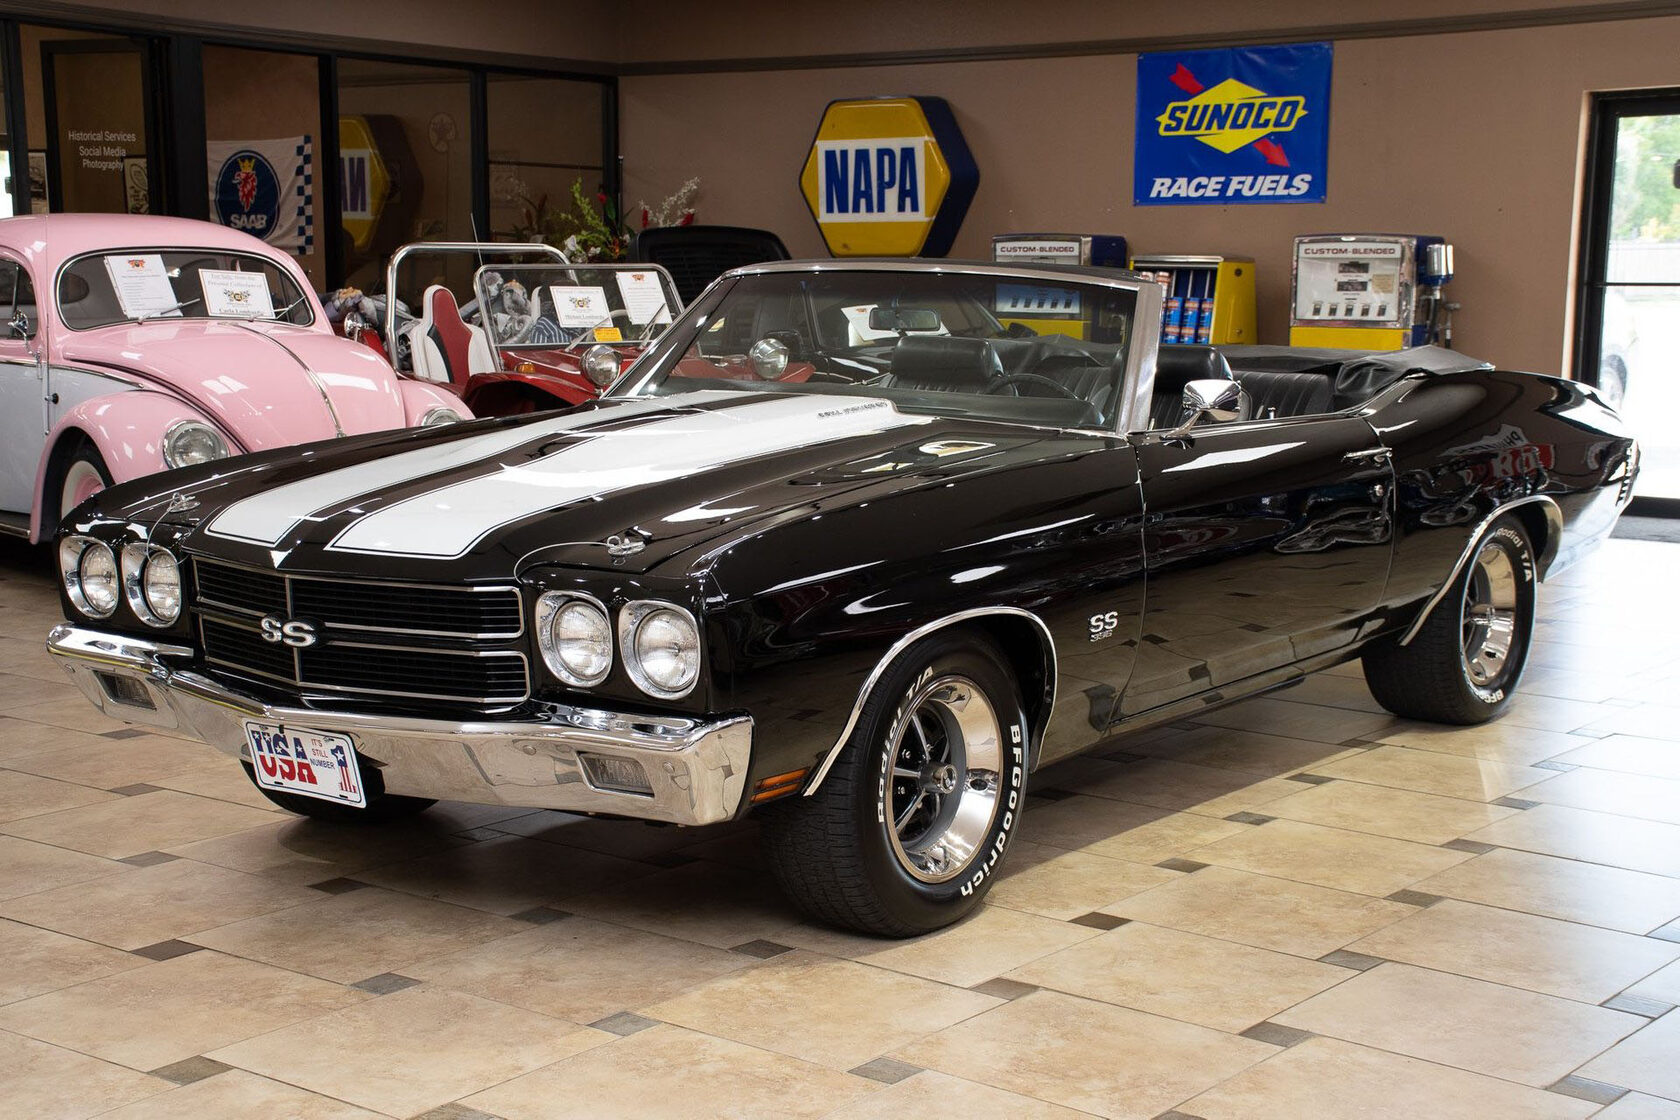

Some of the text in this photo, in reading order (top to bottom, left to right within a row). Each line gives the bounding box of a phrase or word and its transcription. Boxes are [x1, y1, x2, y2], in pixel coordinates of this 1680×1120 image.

[1163, 100, 1301, 133] SUNOCO
[68, 130, 137, 142] Historical Services
[79, 145, 126, 157] Social Media
[82, 158, 124, 172] Photography
[824, 147, 920, 214] NAPA
[1149, 173, 1313, 198] RACE FUELS
[230, 213, 268, 230] SAAB
[1519, 549, 1533, 583] T/A
[261, 618, 316, 647] SS
[1090, 611, 1118, 633] SS
[905, 665, 934, 700] T/A
[311, 738, 324, 748] IT'S
[312, 748, 329, 759] STILL
[251, 730, 319, 786] USA
[309, 758, 336, 770] NUMBER
[960, 724, 1023, 897] BFGoodrich
